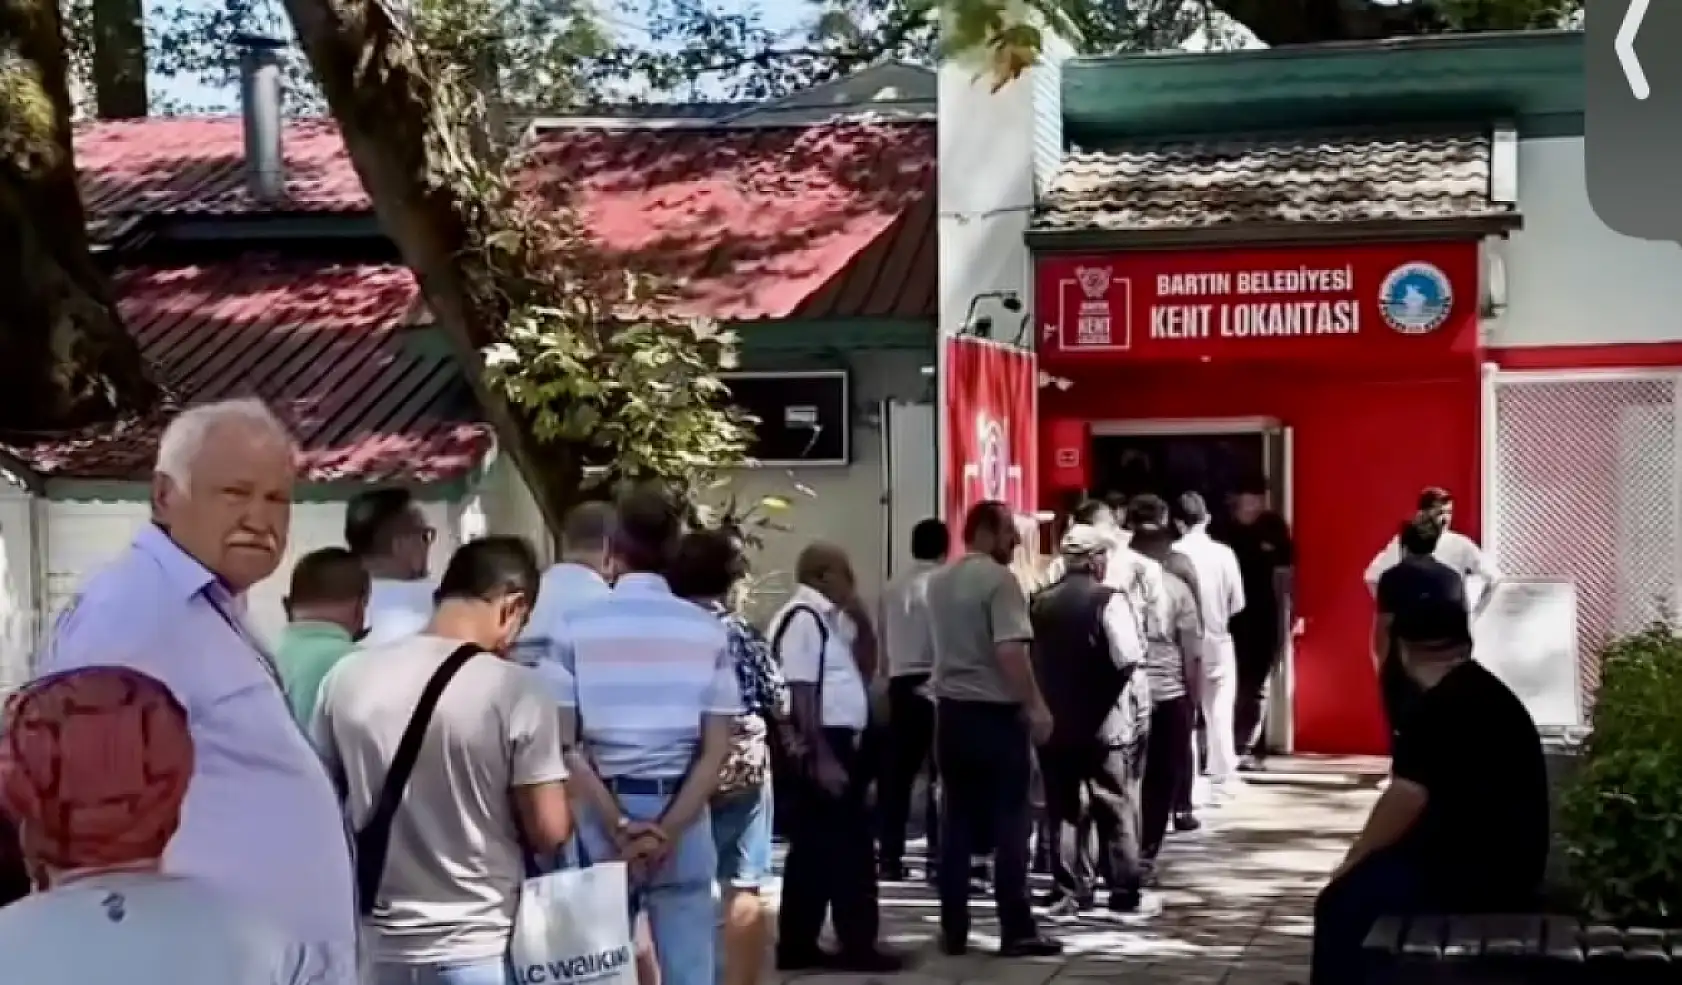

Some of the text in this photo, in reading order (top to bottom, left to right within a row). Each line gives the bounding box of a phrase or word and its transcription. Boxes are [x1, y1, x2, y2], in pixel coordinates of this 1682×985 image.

[1156, 263, 1353, 296] BARTIN BELEDİYESİ
[1150, 299, 1360, 339] KENT LOKANTASI
